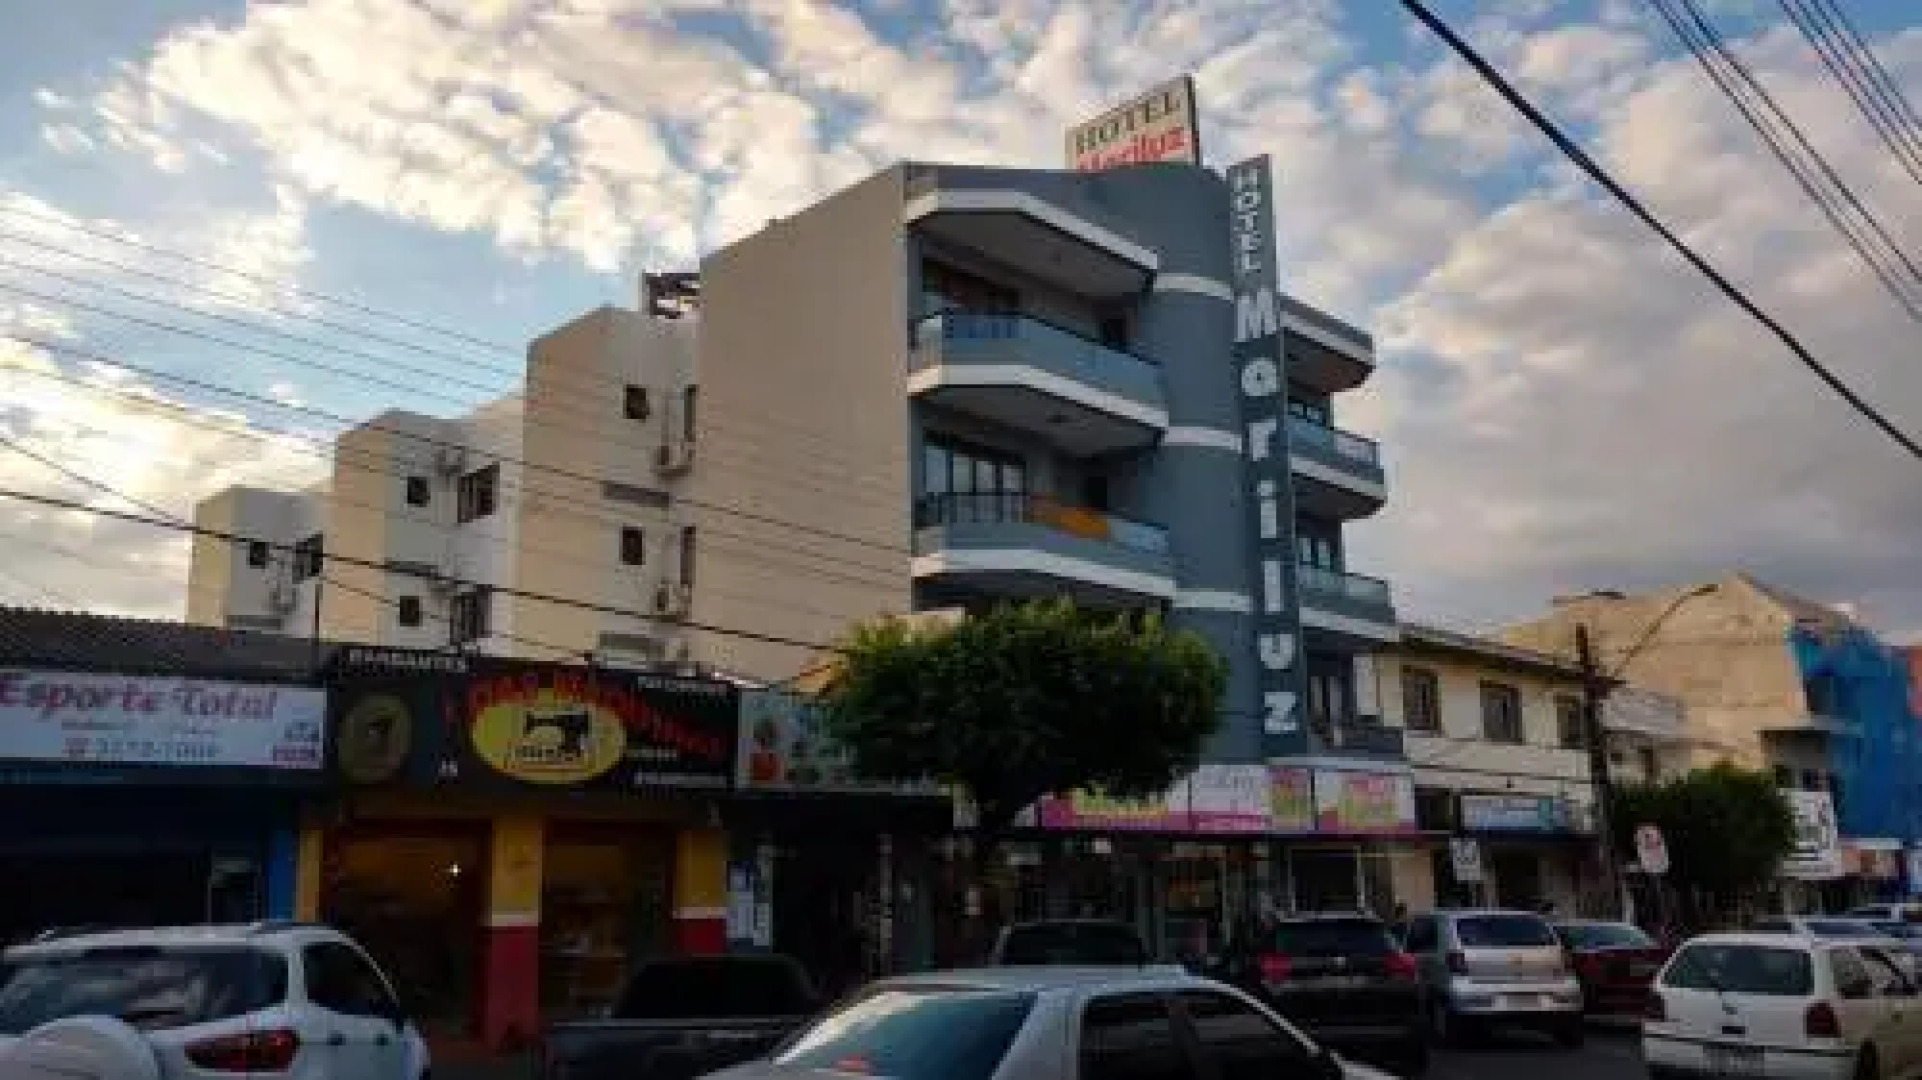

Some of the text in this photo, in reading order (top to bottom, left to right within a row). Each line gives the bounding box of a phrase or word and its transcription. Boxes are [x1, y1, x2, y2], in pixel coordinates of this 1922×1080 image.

[1076, 91, 1182, 151] HOTEL
[1234, 167, 1262, 274] HOTEL
[0, 672, 279, 720] Esporte Total
